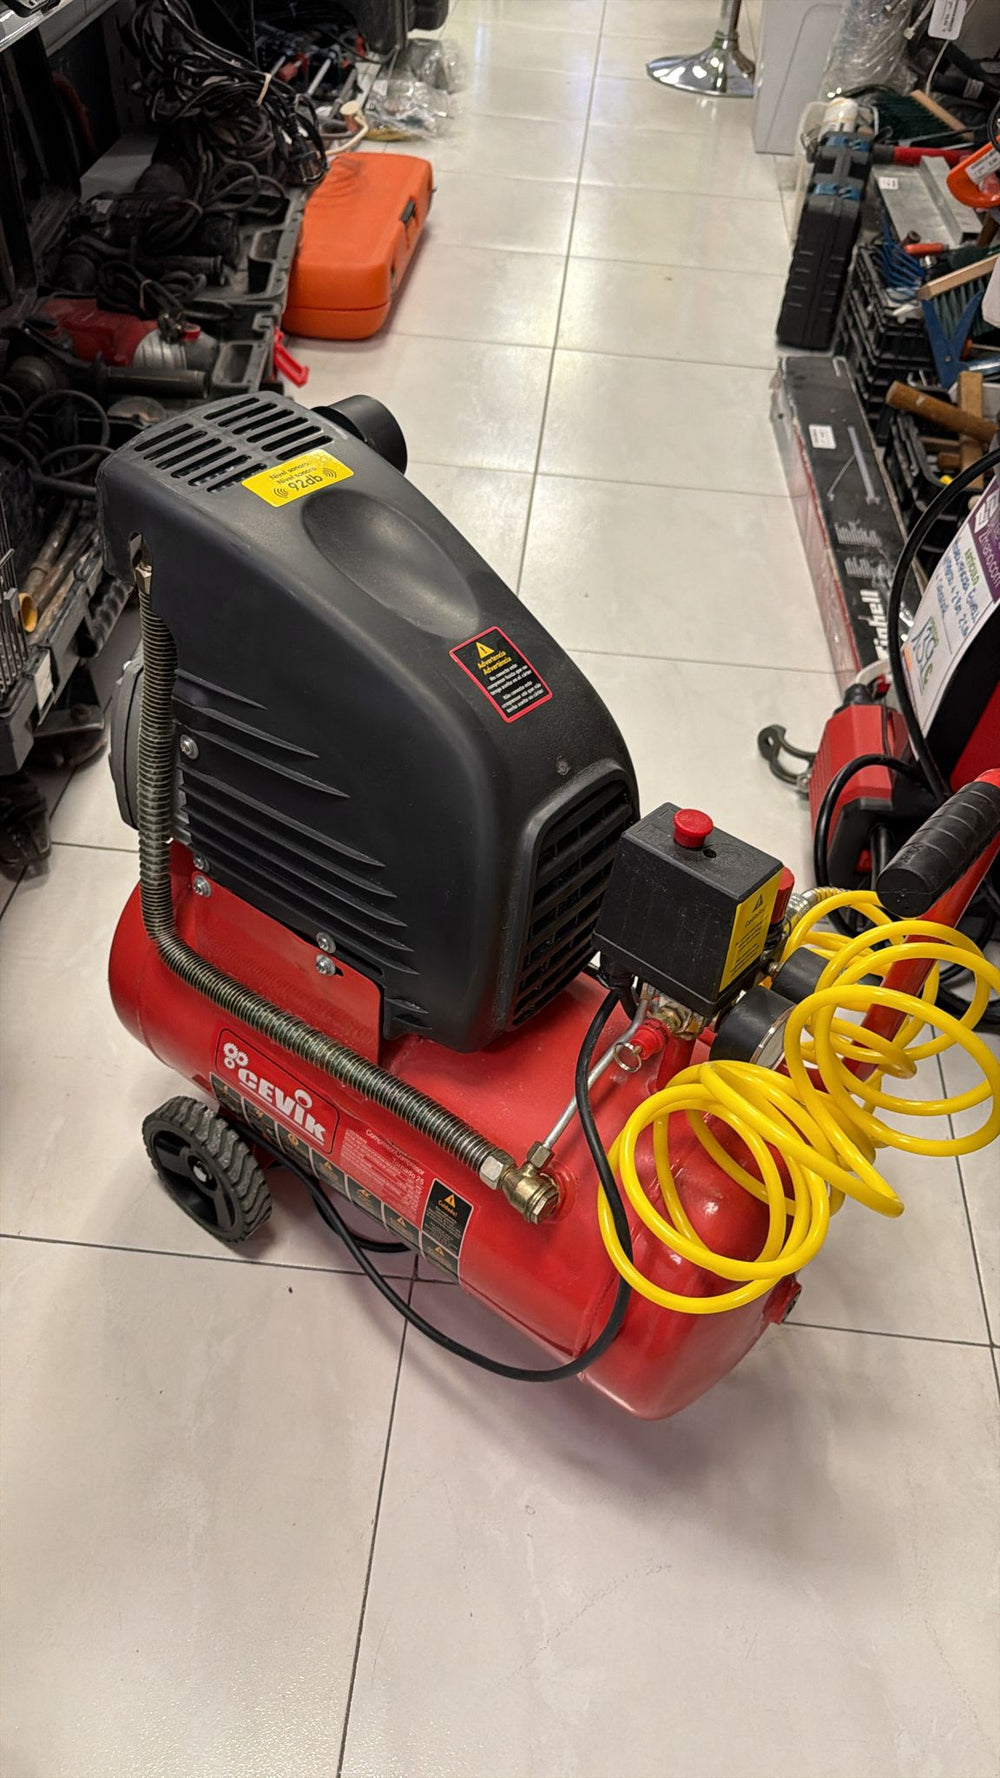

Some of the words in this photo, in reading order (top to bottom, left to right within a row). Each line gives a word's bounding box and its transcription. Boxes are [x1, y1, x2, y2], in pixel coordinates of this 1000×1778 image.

[270, 470, 287, 480] Nivel
[276, 475, 295, 485] Nivel
[288, 474, 323, 491] 92db
[391, 1158, 416, 1179] Tornado
[416, 1175, 424, 1185] 25
